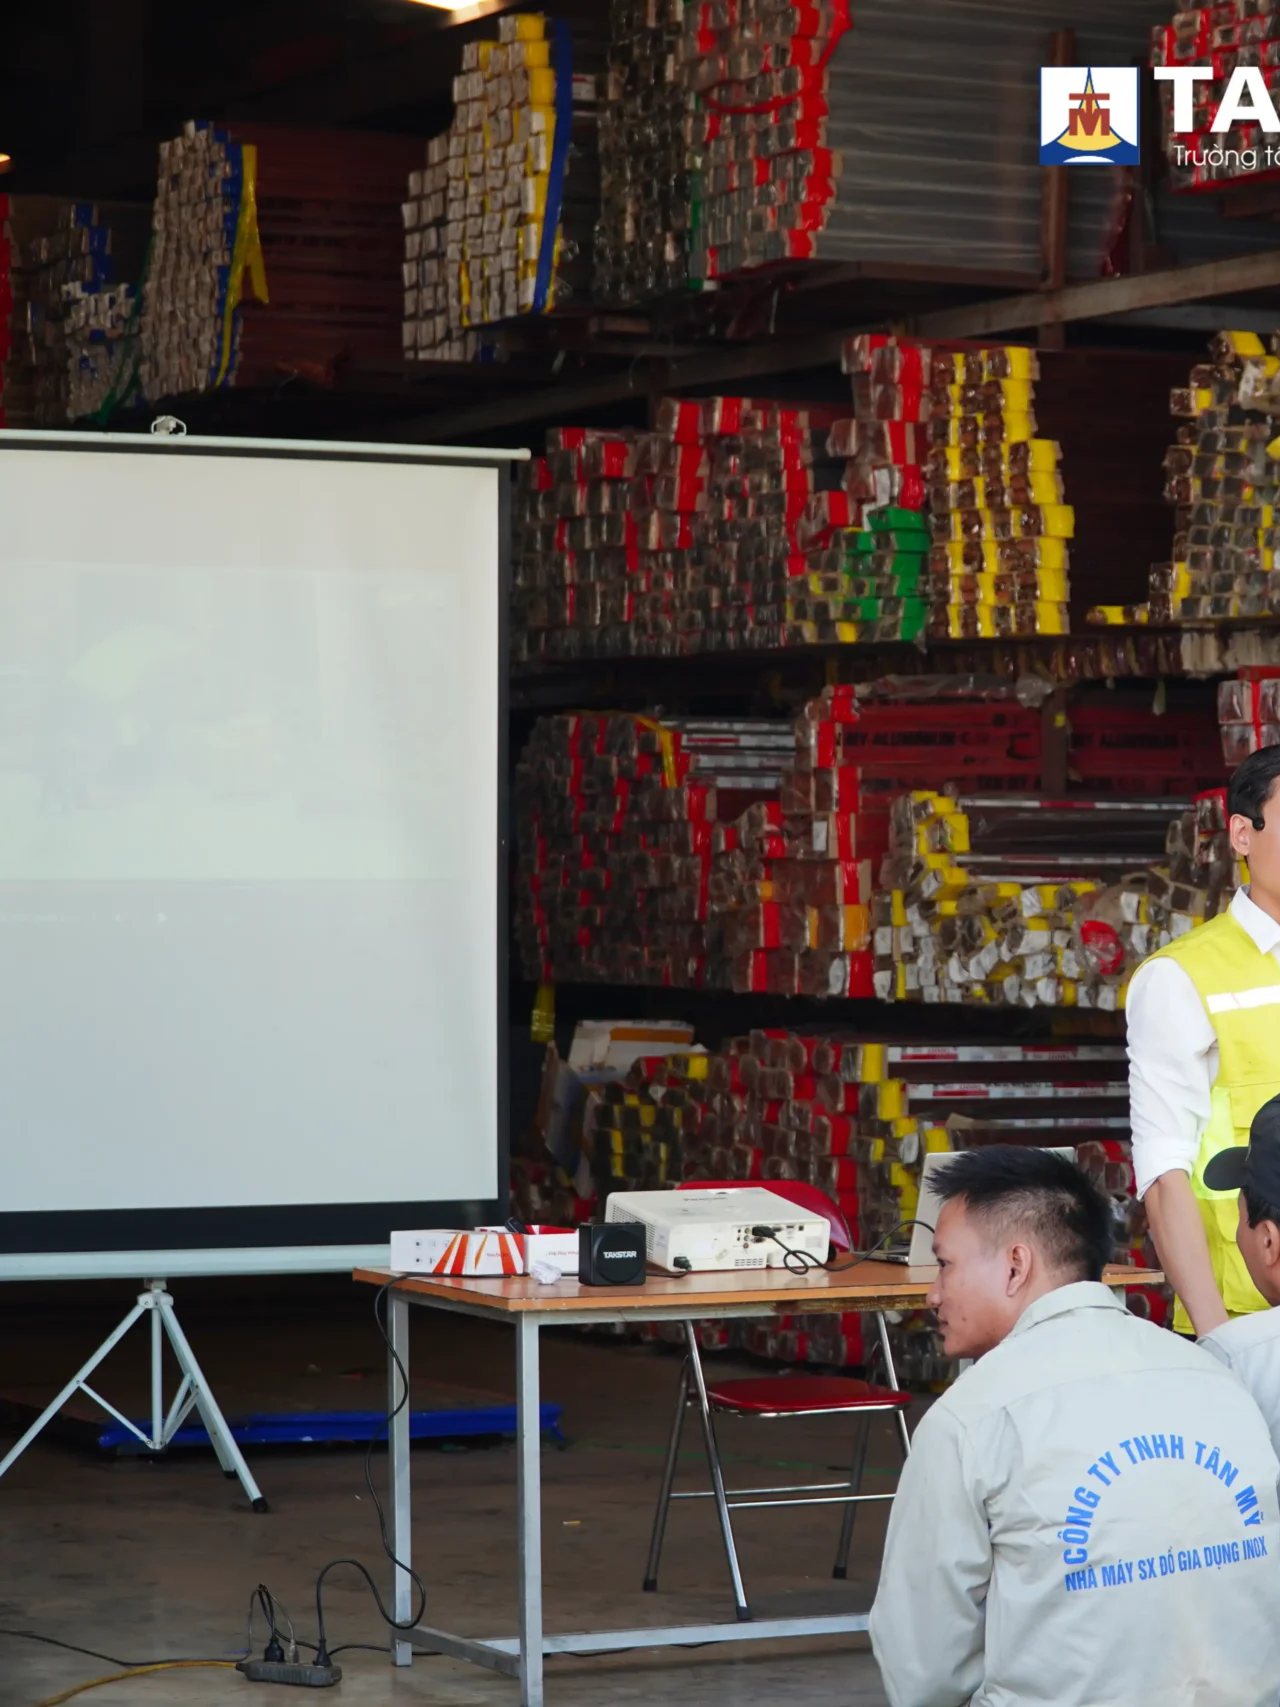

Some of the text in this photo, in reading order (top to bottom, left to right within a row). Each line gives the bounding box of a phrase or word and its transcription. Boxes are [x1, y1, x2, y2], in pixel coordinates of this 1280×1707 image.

[603, 1250, 638, 1260] TAKSTAR
[1057, 1433, 1264, 1565] CÔNG TY TNHH TÂN MỸ
[1064, 1564, 1098, 1592] NHÀ
[1101, 1559, 1134, 1587] MÁY
[1137, 1556, 1158, 1582] SX
[1177, 1549, 1202, 1572] GIA
[1203, 1541, 1240, 1570] DỤNG
[1242, 1535, 1268, 1561] INOX
